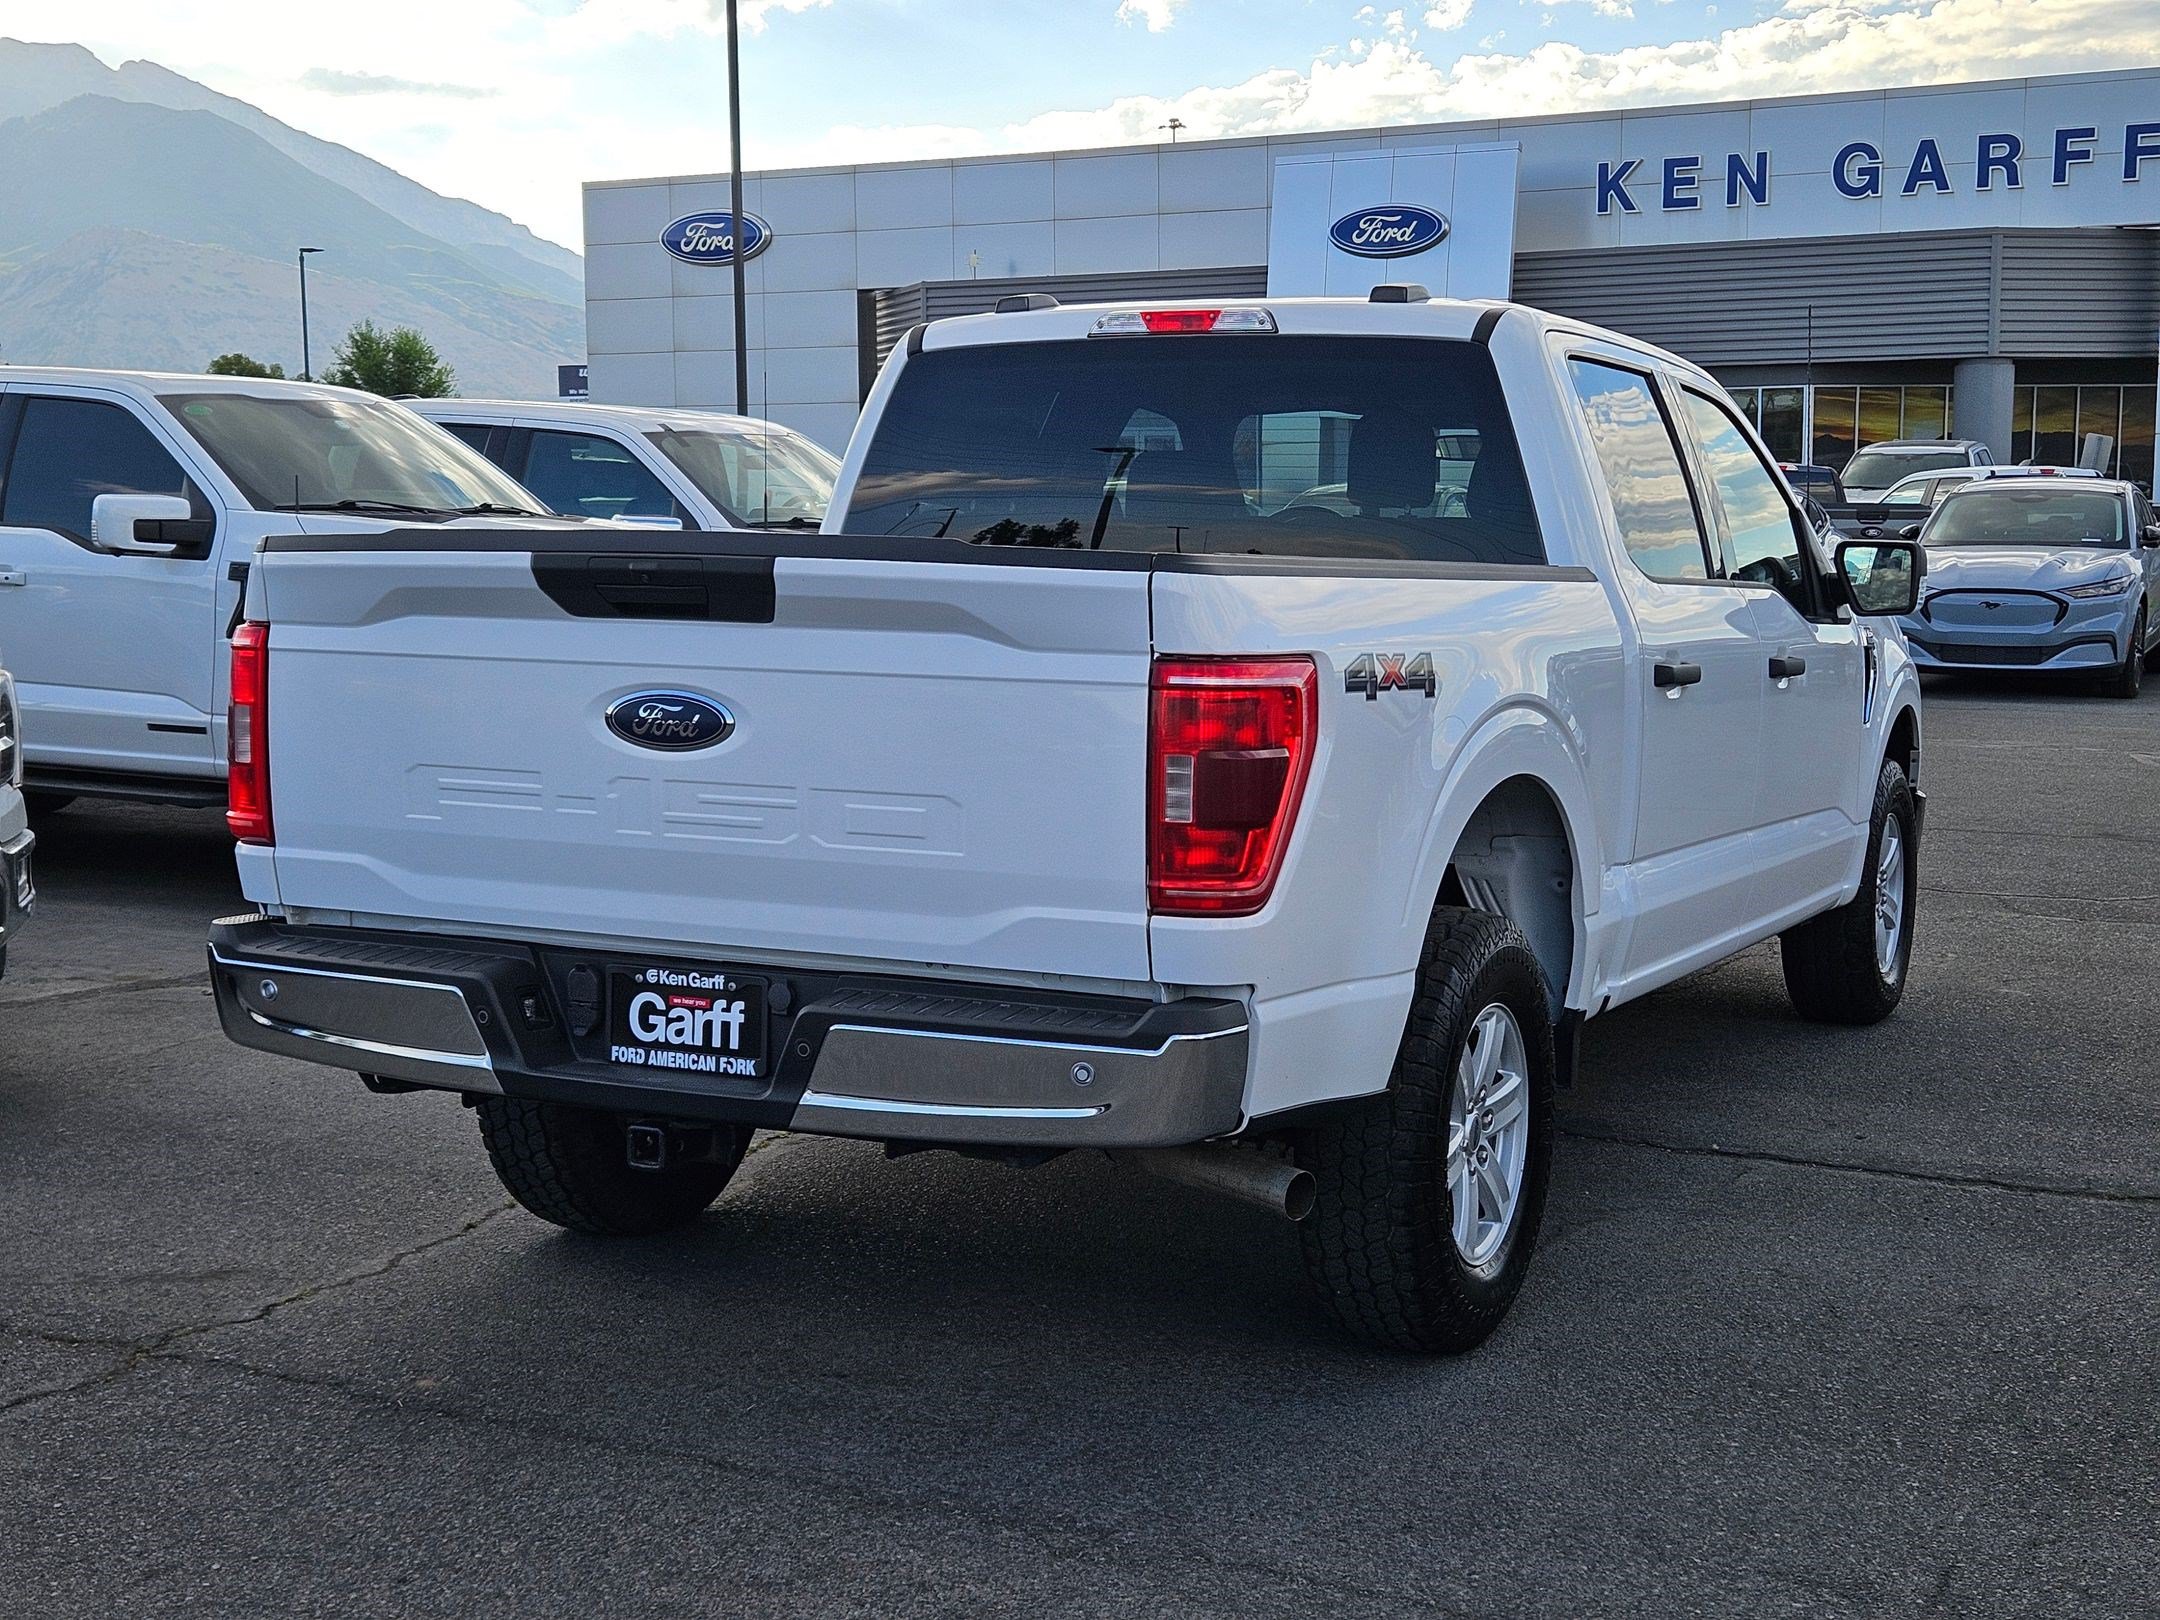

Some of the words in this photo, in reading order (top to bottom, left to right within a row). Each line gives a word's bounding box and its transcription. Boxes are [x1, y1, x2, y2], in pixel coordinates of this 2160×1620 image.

[1596, 150, 1769, 215] KEN
[1831, 121, 2160, 199] GARFF
[1352, 215, 1418, 244] Ford
[632, 702, 700, 738] Ford
[404, 763, 964, 857] F-150
[659, 970, 688, 986] Ken
[688, 972, 725, 990] Garff
[629, 991, 745, 1050] Garff
[611, 1045, 645, 1065] FORD
[647, 1049, 716, 1072] AMERICAN
[719, 1057, 756, 1076] FORK
